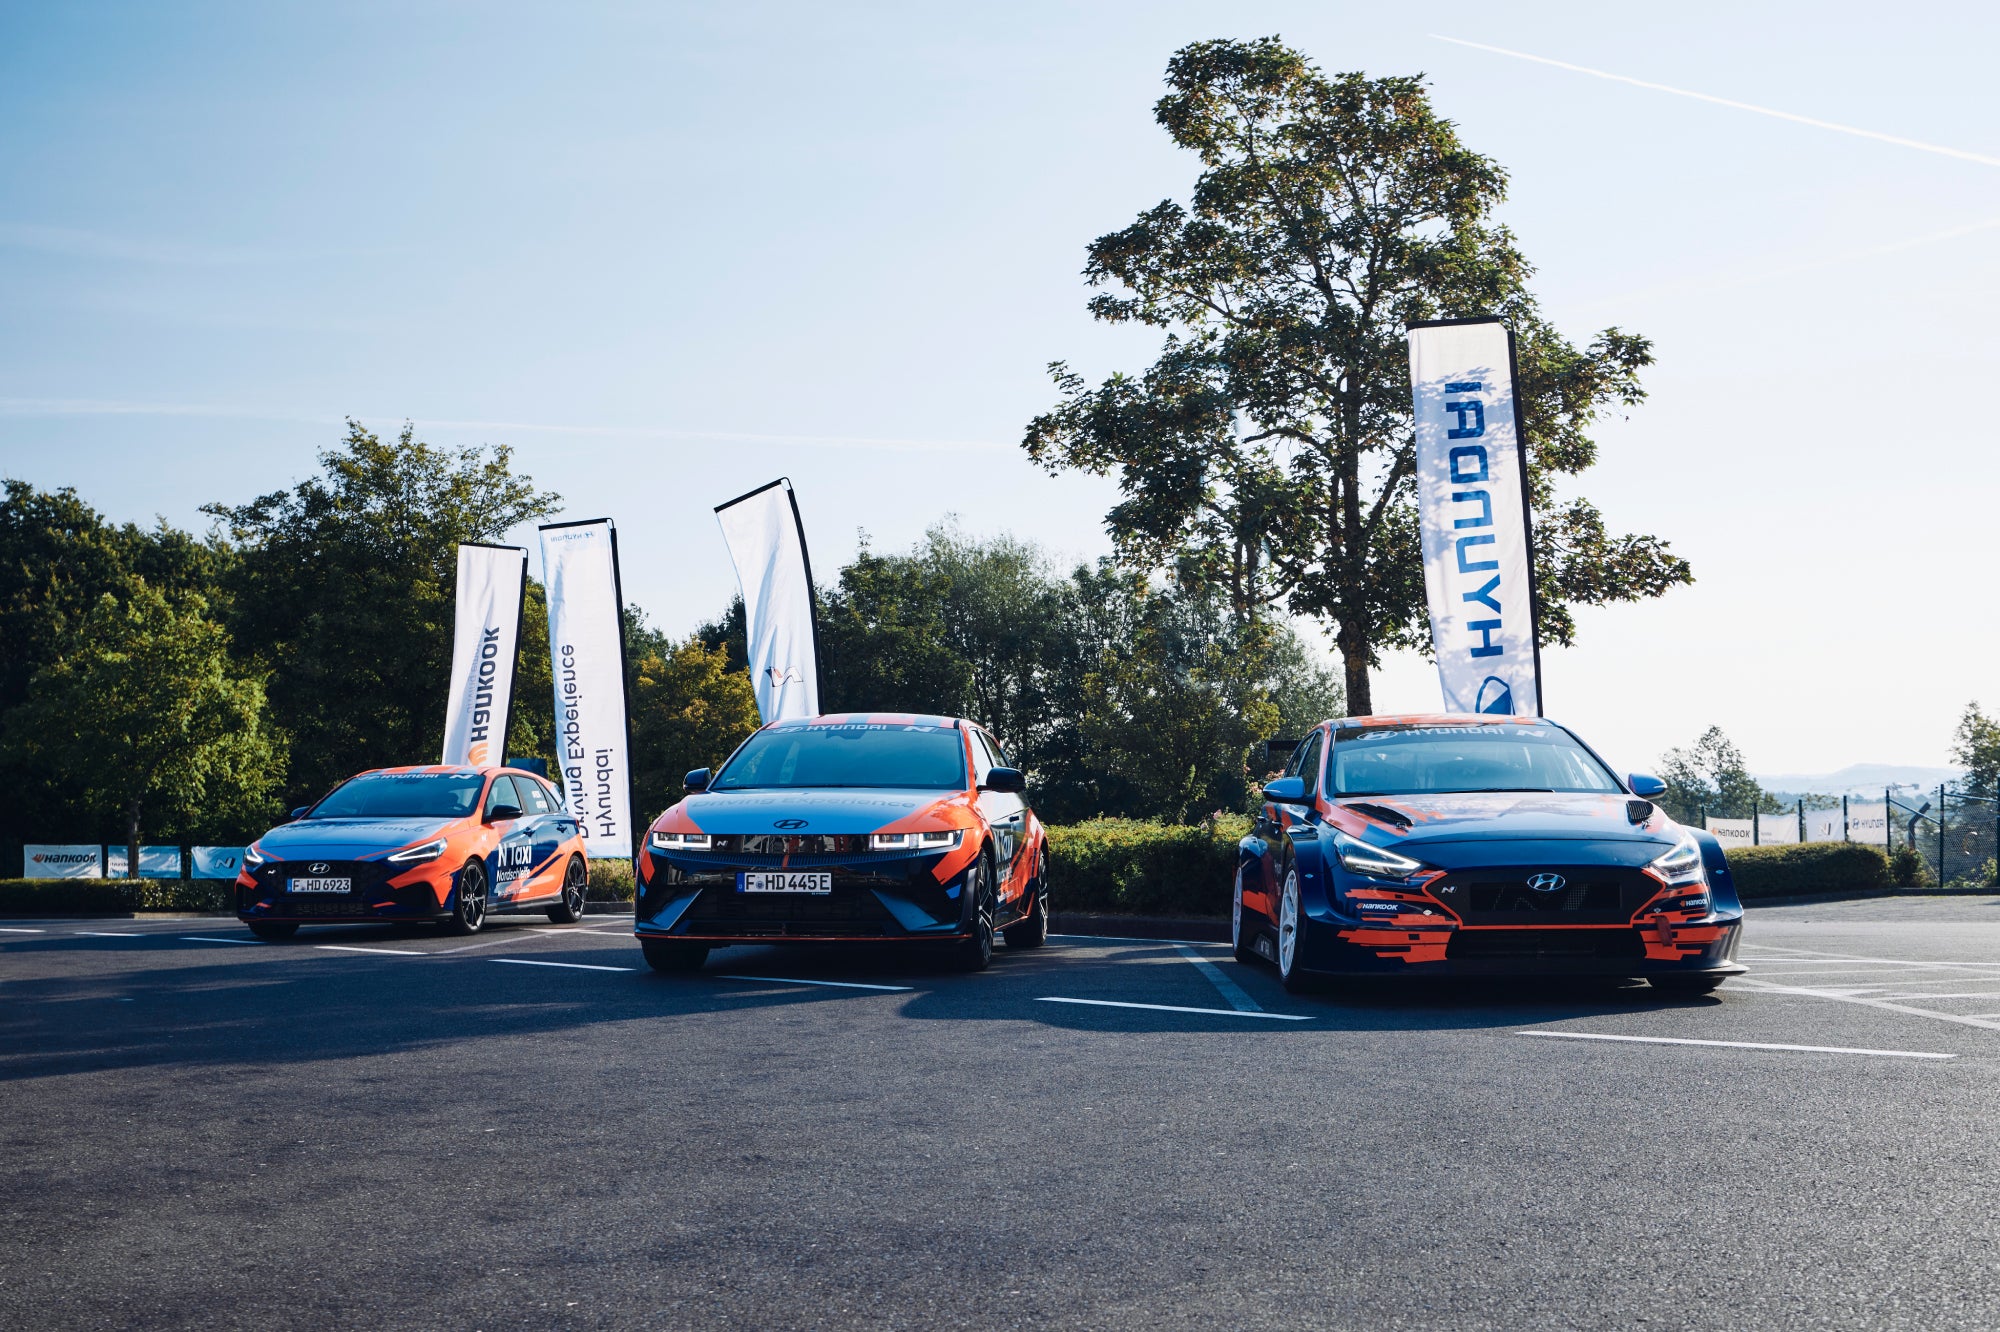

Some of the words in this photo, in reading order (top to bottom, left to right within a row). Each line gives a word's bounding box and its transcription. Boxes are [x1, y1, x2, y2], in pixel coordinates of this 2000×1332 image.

[806, 724, 887, 732] HYUNDAI
[1405, 727, 1505, 736] HYUNDAI
[497, 842, 507, 867] N
[509, 839, 532, 866] Taxi
[496, 866, 531, 882] Nordschleife
[293, 880, 301, 890] F
[307, 880, 321, 890] HD
[323, 879, 350, 890] 6923
[746, 875, 756, 890] F
[765, 875, 785, 890] HD
